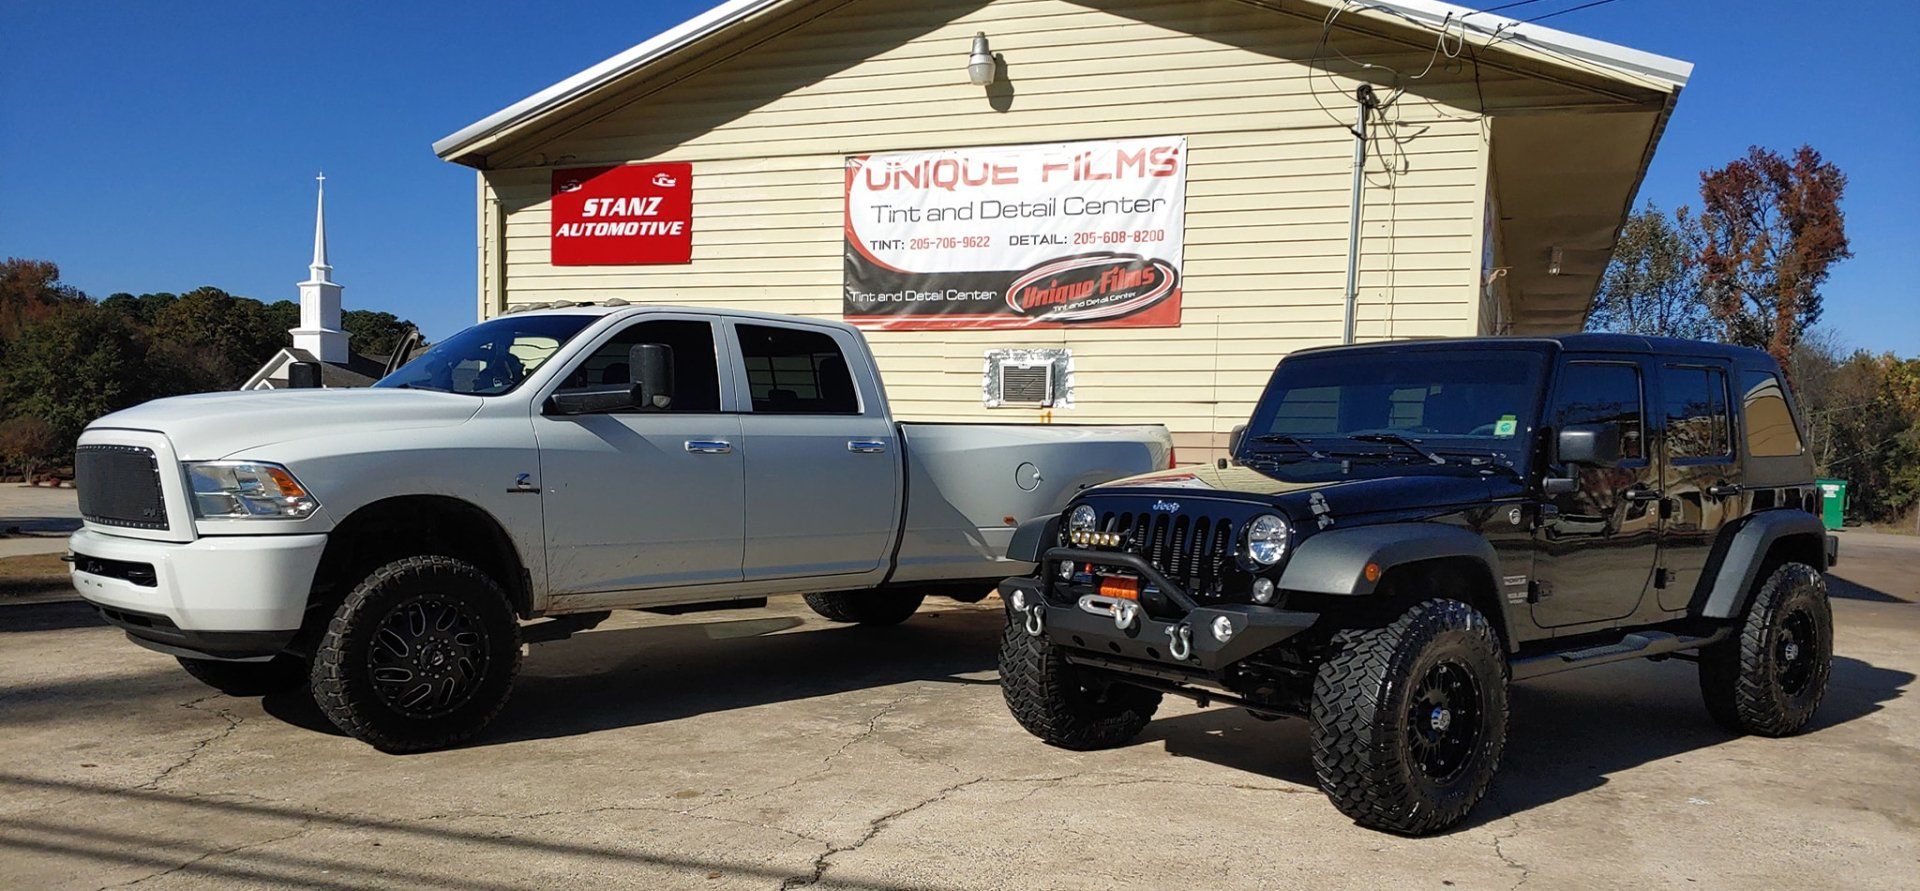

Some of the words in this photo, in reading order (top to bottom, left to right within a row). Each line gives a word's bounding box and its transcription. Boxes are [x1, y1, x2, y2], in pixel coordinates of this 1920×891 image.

[865, 157, 1019, 191] UNIQUE
[1042, 146, 1179, 182] FILMS
[582, 197, 663, 217] STANZ
[871, 205, 921, 223] Tint
[926, 201, 973, 222] and
[980, 198, 1056, 219] Detail
[1063, 197, 1166, 216] Center
[556, 221, 684, 237] AUTOMOTIVE
[870, 239, 904, 251] TINT:
[910, 236, 990, 250] 205-706-9622
[1009, 234, 1067, 246] DETAIL:
[1073, 229, 1165, 245] 205-608-8200
[850, 291, 876, 302] Tint
[877, 290, 903, 302] and
[905, 290, 943, 301] Detail
[946, 289, 998, 300] Center
[1022, 279, 1095, 309] Unique
[1099, 265, 1155, 294] Films
[1052, 304, 1067, 313] Tint
[1069, 300, 1084, 310] and
[1110, 291, 1136, 302] Center
[1153, 500, 1180, 513] Jeep
